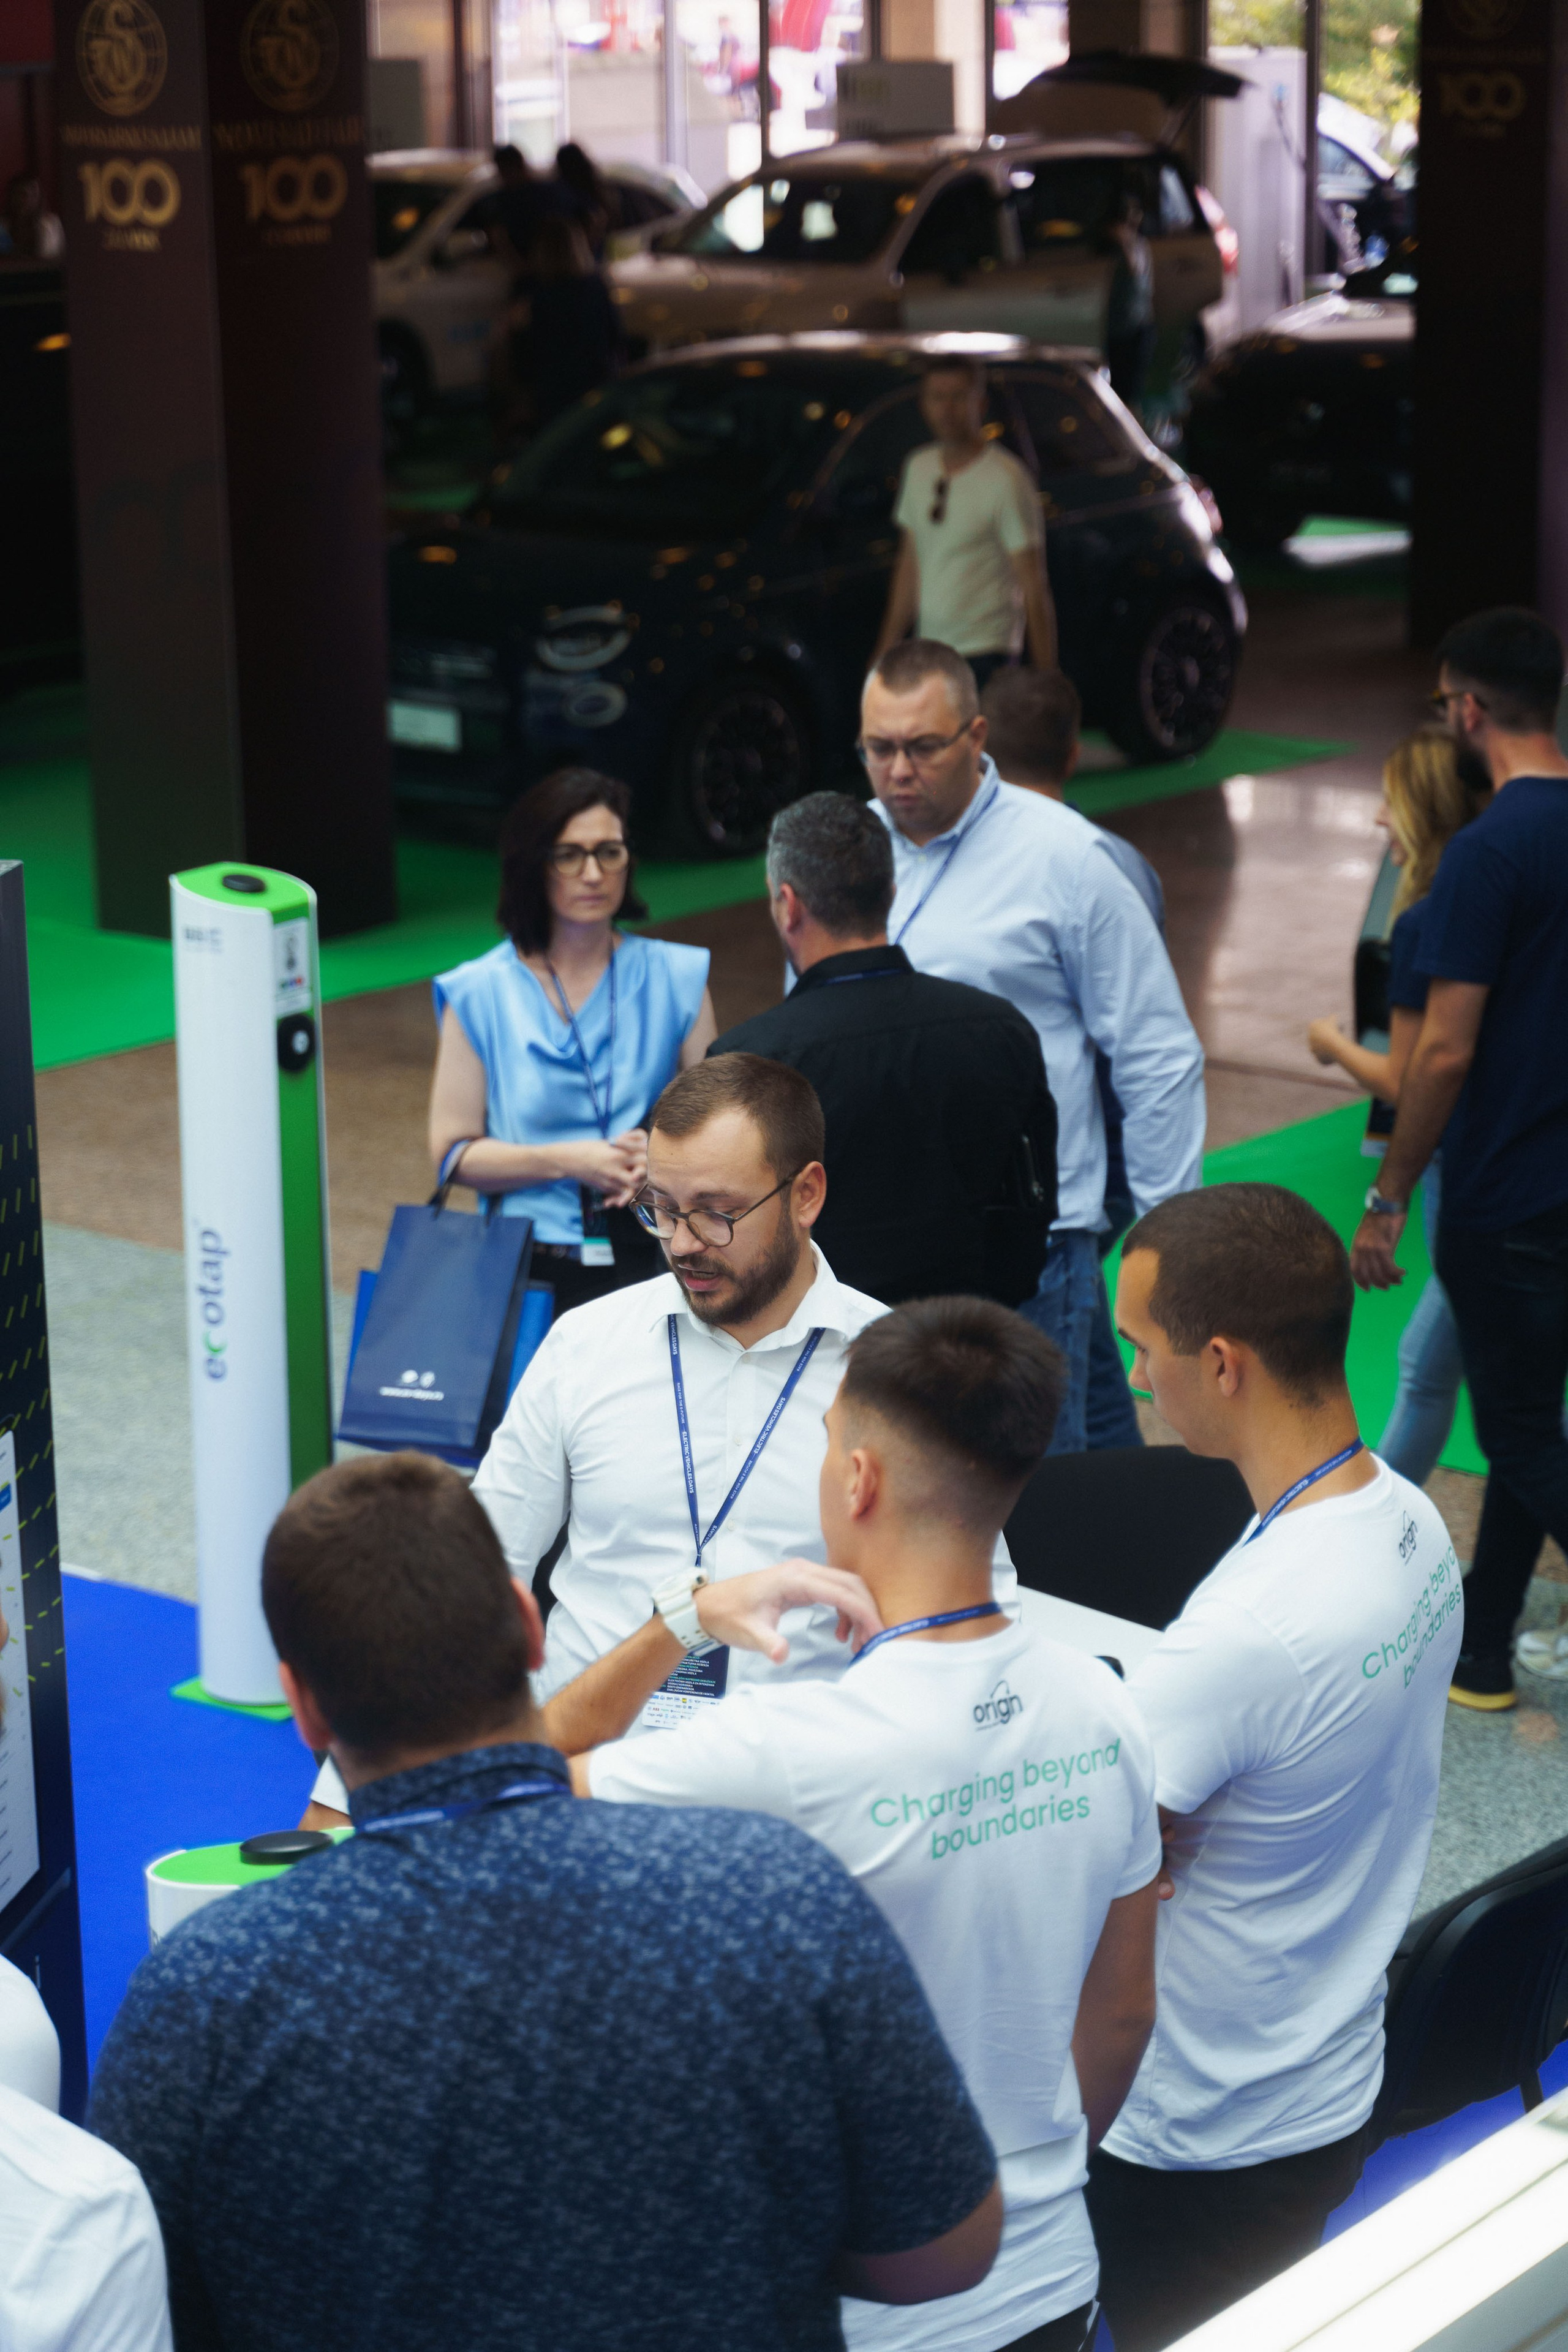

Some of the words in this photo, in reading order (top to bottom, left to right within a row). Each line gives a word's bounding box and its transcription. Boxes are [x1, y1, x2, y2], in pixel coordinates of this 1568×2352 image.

[78, 158, 181, 227] 100
[243, 154, 349, 223] 100
[198, 1230, 230, 1380] ecotap
[754, 1431, 768, 1454] ELECTRIC
[765, 1409, 780, 1432] VEHICLES
[777, 1397, 786, 1410] DAYS
[707, 1525, 718, 1539] DAYS
[1362, 1586, 1431, 1679] Charging
[1430, 1545, 1456, 1594] beyo
[1403, 1583, 1461, 1689] boundaries
[870, 1770, 1015, 1828] Charging
[1023, 1737, 1121, 1789] beyond
[932, 1795, 1090, 1860] boundaries
